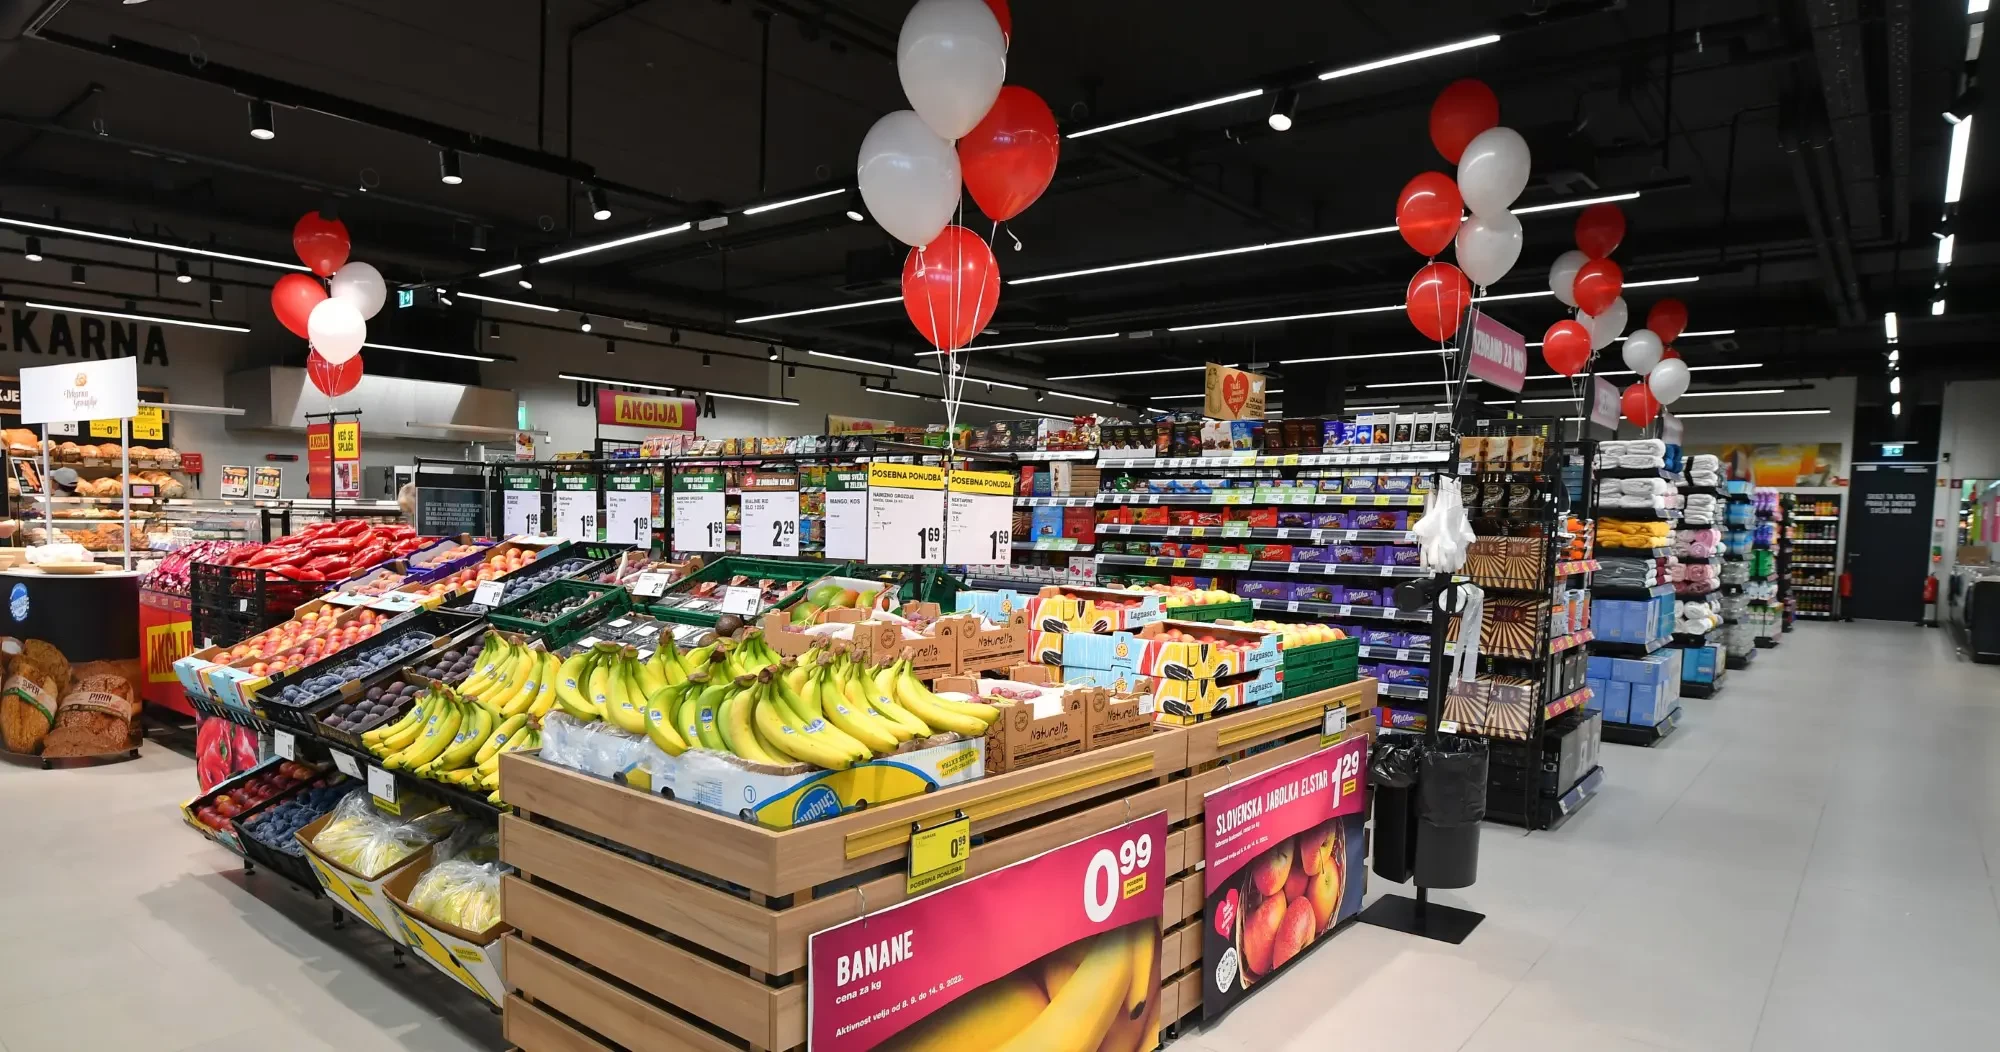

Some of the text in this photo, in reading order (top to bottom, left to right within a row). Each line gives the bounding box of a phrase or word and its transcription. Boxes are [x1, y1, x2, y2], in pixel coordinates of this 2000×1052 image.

[620, 399, 677, 424] AKCIJA
[871, 469, 942, 482] POSEBNA PONUDBA
[951, 476, 1012, 489] POSEBNA PONUDBA
[1318, 515, 1337, 525] Milka
[1357, 514, 1379, 525] Milka
[1299, 551, 1320, 561] Milka
[1394, 551, 1418, 561] Milka
[1243, 583, 1263, 593] Milka
[1296, 586, 1316, 596] Milka
[1349, 592, 1369, 601] Milka
[1130, 609, 1157, 621] Lagnasco
[978, 634, 1013, 649] Naturella
[1370, 632, 1390, 641] Milka
[1409, 634, 1431, 644] Milka
[1249, 649, 1274, 662] Lagnasco
[1388, 668, 1410, 678] Milka
[21, 679, 41, 696] SUPER
[1248, 681, 1273, 695] Lagnasco
[1391, 714, 1415, 725] Milka
[1030, 722, 1069, 742] Naturella
[1215, 795, 1263, 837] SLOVENSKA
[1265, 782, 1299, 813] JABOLKA
[1300, 769, 1329, 798] ELSTAR
[910, 876, 936, 890] POSEBNA
[836, 929, 914, 987] BANANE
[835, 980, 882, 1005] cena za kg
[835, 1015, 872, 1038] Aktivnost
[872, 1008, 890, 1020] velja
[891, 1001, 901, 1013] od
[902, 1000, 909, 1009] 8.
[910, 996, 917, 1005] 9.
[918, 992, 927, 1001] do
[928, 987, 938, 996] 14.
[939, 983, 946, 991] 9.
